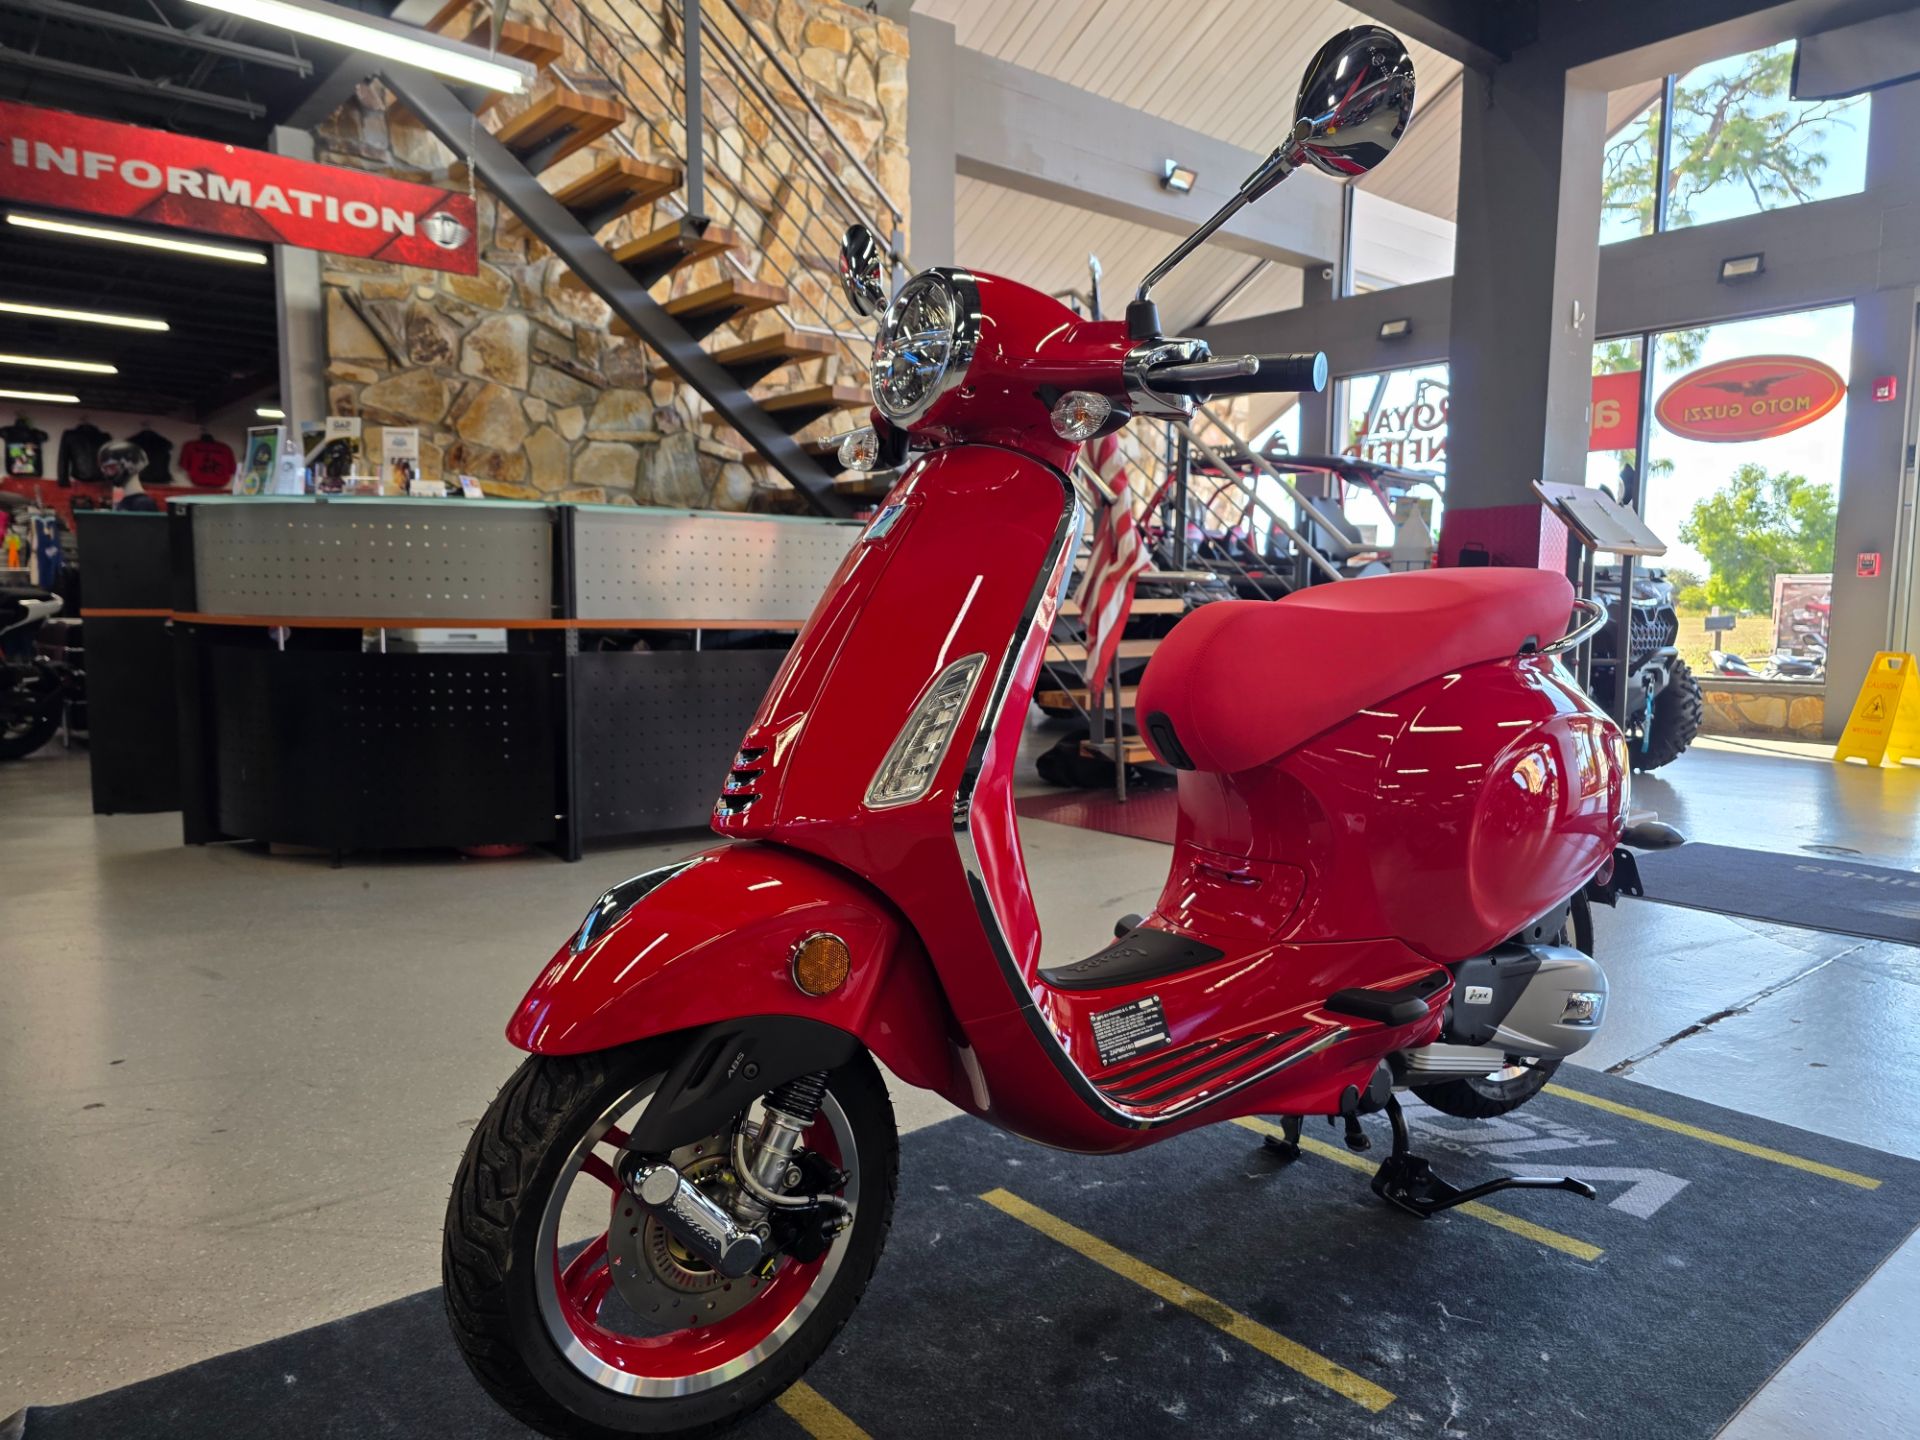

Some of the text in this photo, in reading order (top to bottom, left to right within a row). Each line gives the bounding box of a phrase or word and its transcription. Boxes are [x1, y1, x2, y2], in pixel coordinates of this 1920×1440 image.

[11, 137, 416, 237] INFORMATION
[1865, 680, 1900, 691] CAUTION
[728, 1051, 745, 1079] ABS
